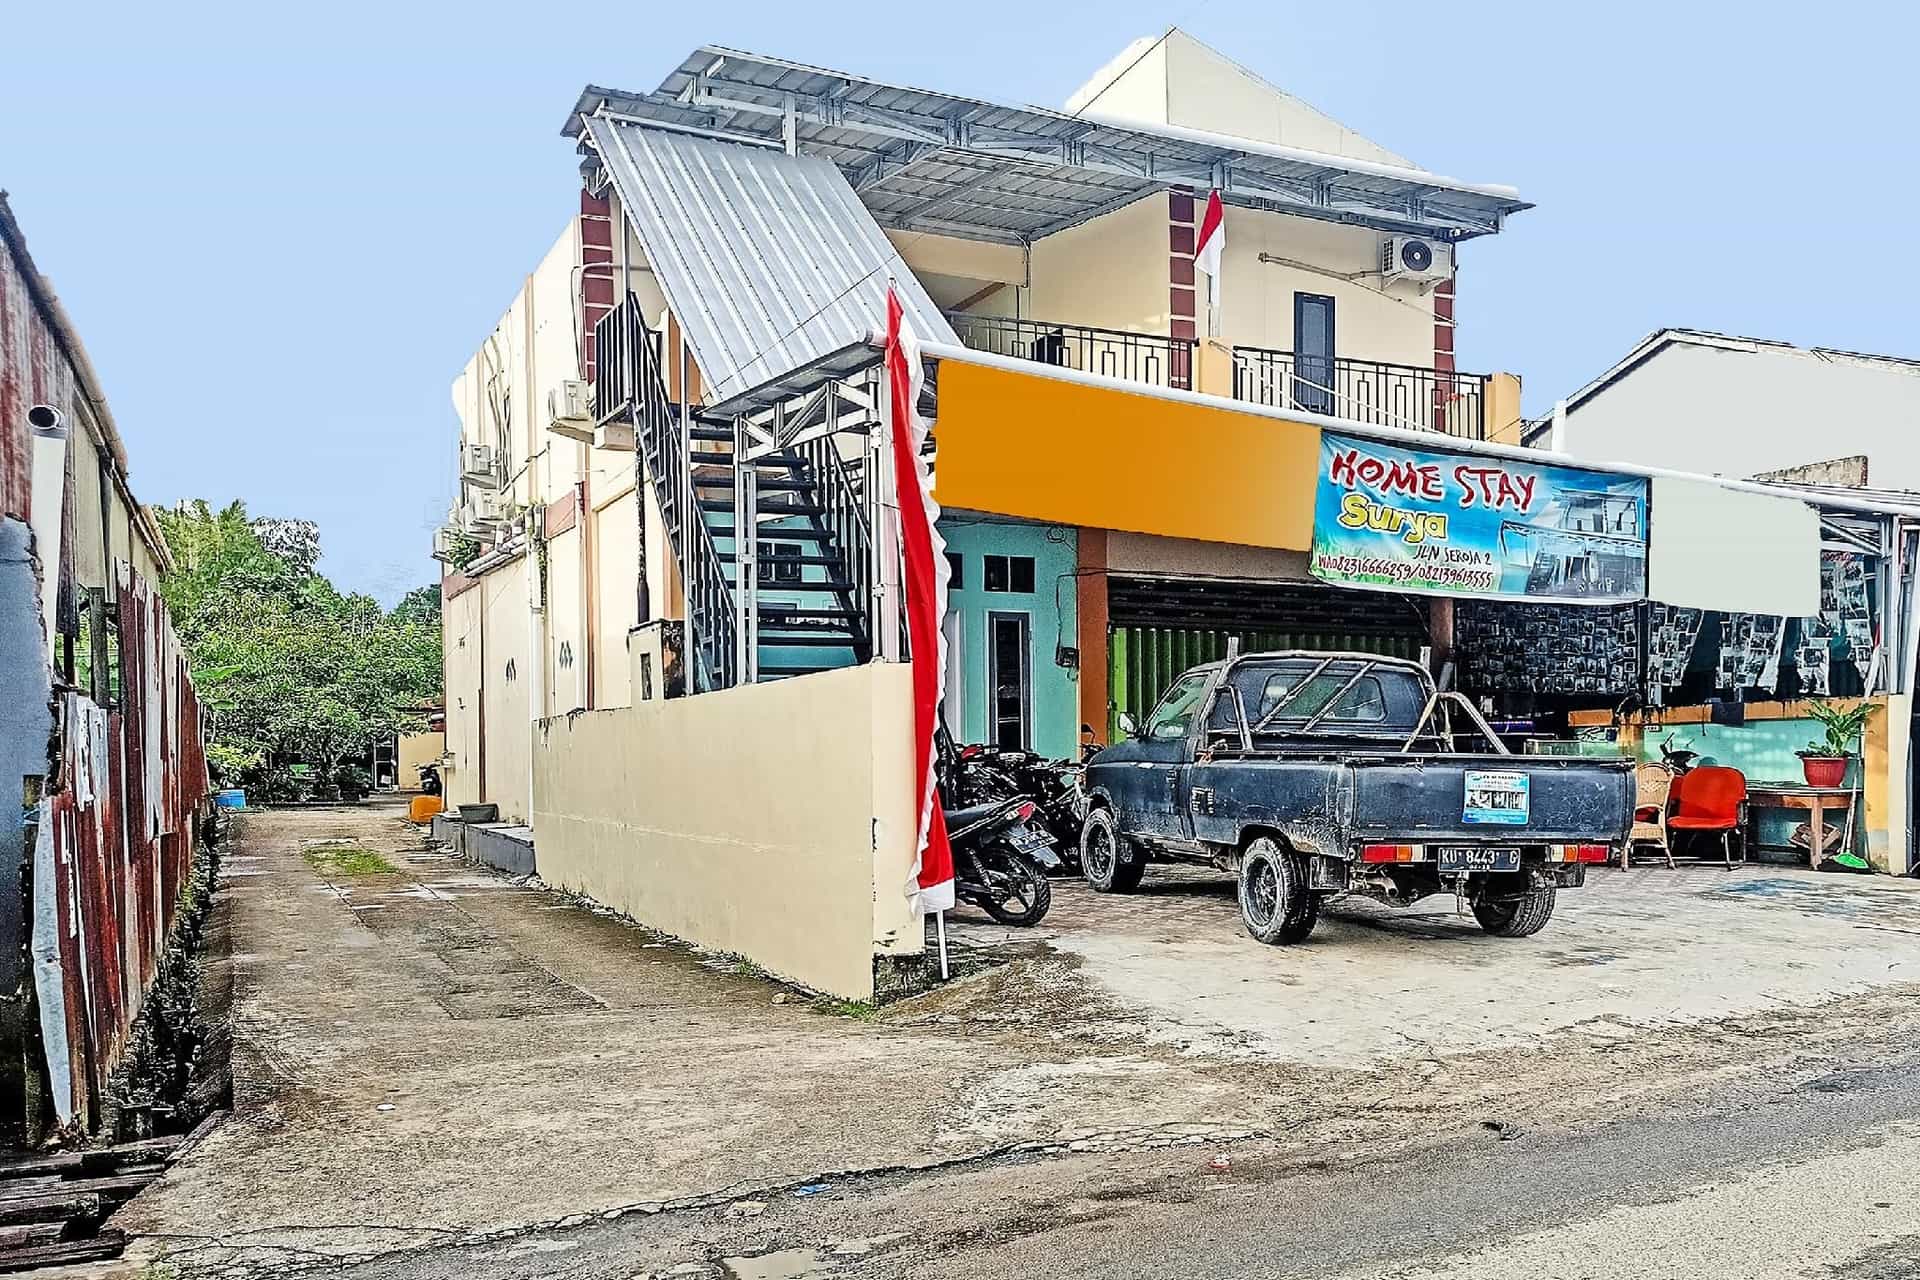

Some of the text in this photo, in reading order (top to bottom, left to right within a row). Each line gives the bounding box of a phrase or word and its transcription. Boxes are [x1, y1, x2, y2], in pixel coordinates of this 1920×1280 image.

[1331, 450, 1536, 511] HOME STAY
[1340, 493, 1447, 544] Surya
[1413, 544, 1492, 566] JLN SEROJA 2
[1441, 849, 1518, 865] KU 8443 G
